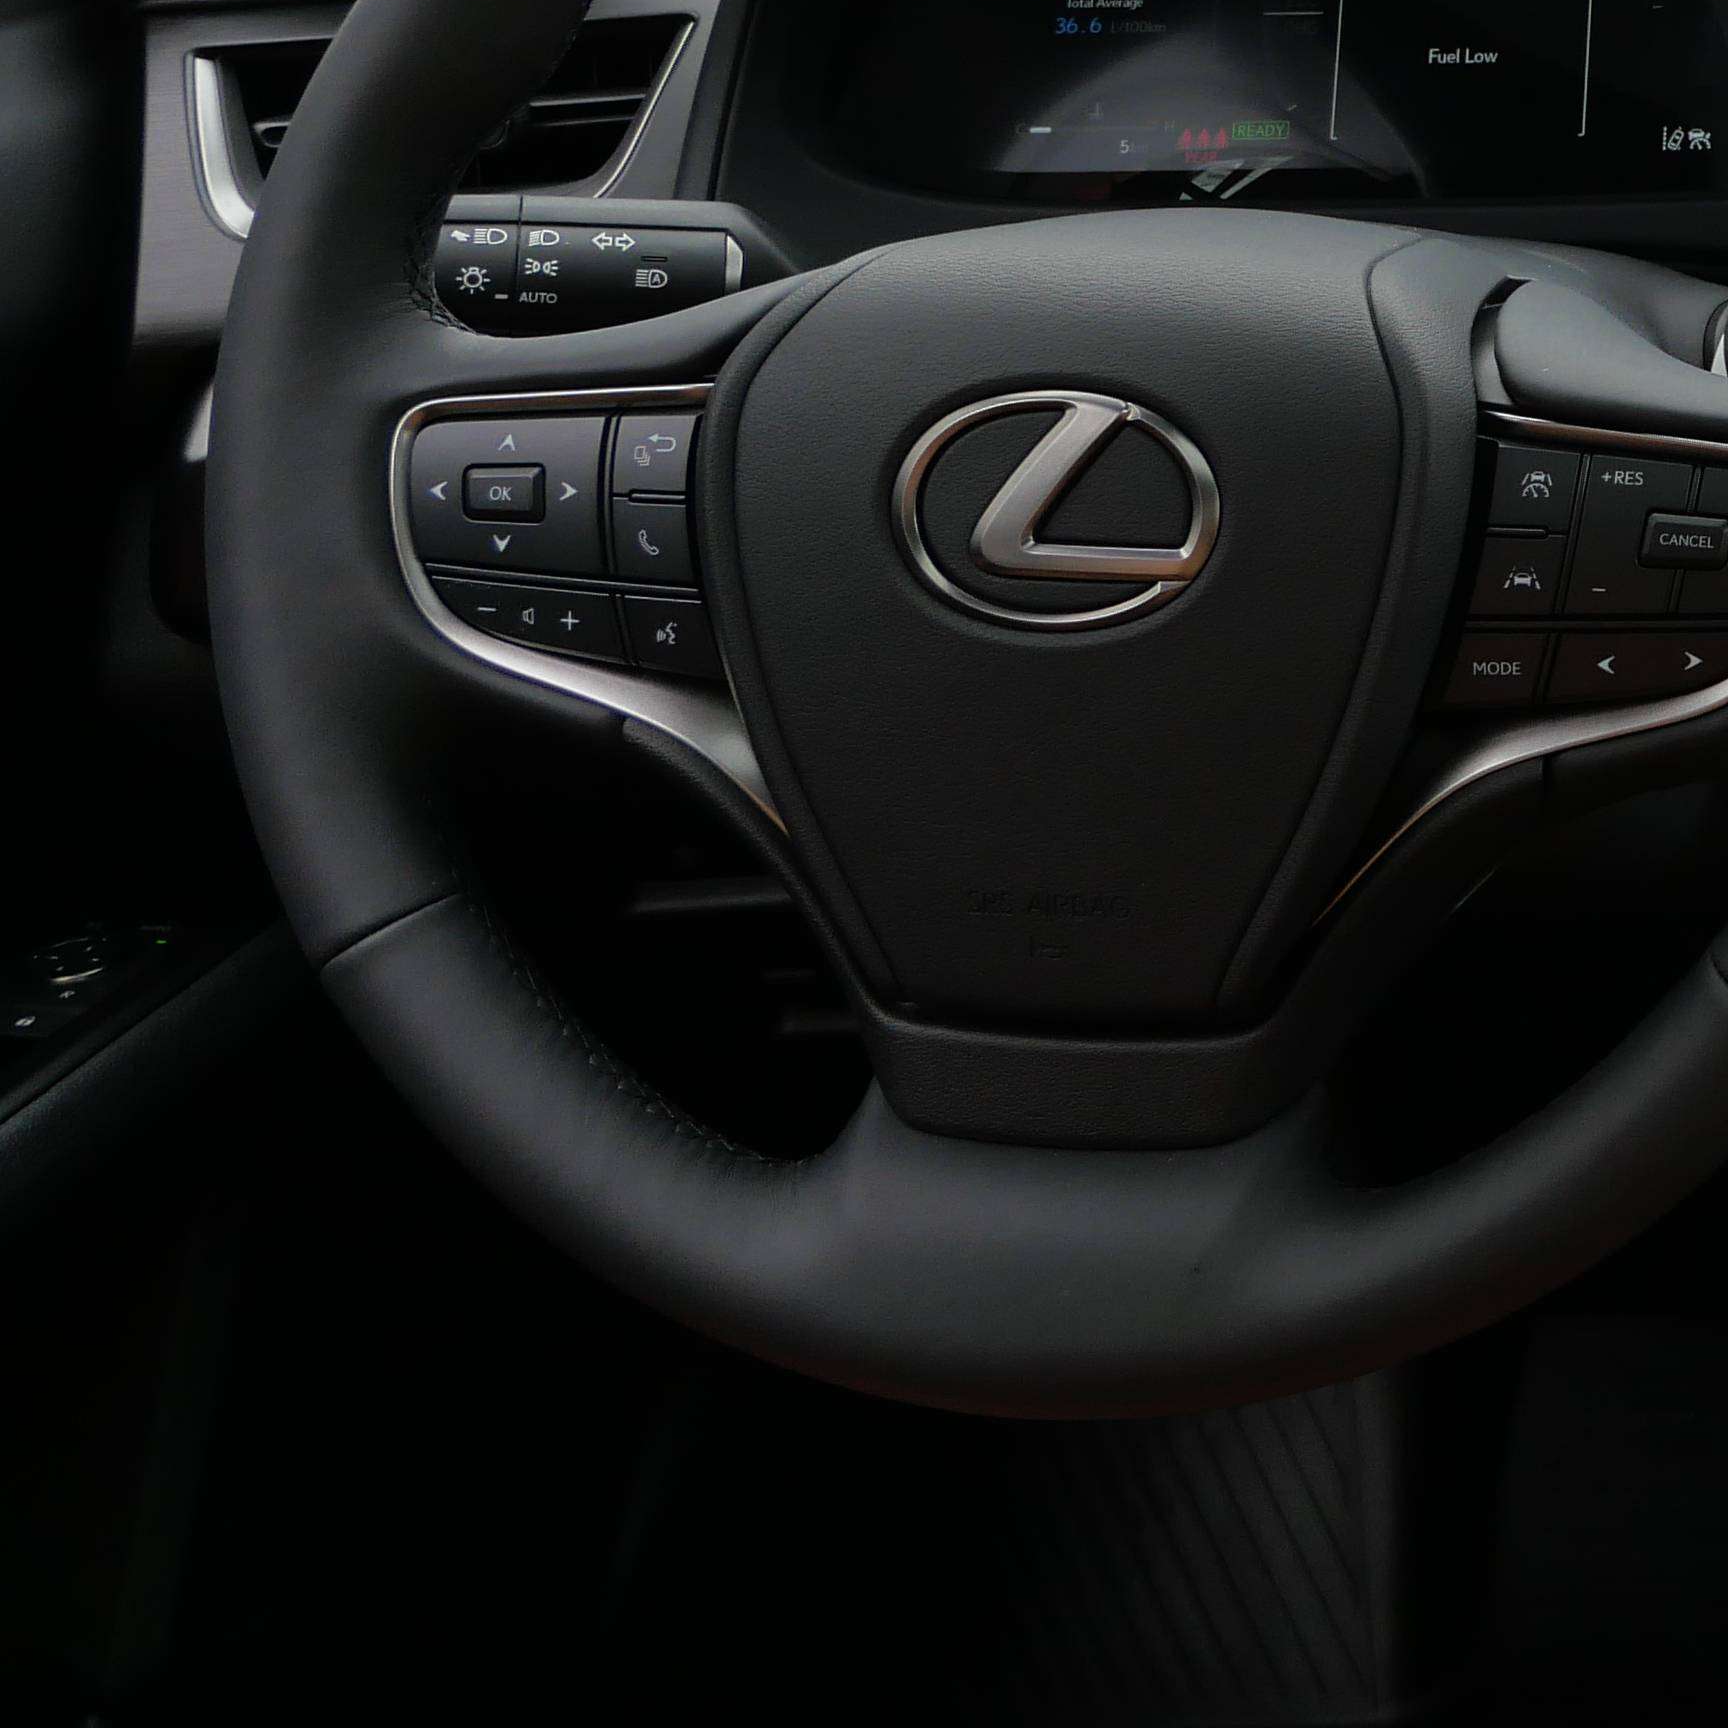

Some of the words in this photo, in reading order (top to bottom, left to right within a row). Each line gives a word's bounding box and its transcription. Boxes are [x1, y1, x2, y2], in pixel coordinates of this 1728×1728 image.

[1055, 16, 1103, 34] 36.6
[1428, 48, 1460, 64] Fuel
[1464, 49, 1498, 64] Low
[1237, 123, 1286, 137] READY
[1120, 139, 1130, 154] 5
[518, 292, 558, 304] AUTO
[489, 485, 513, 502] OK
[1659, 533, 1715, 550] CANCEL
[1472, 661, 1522, 676] MODE
